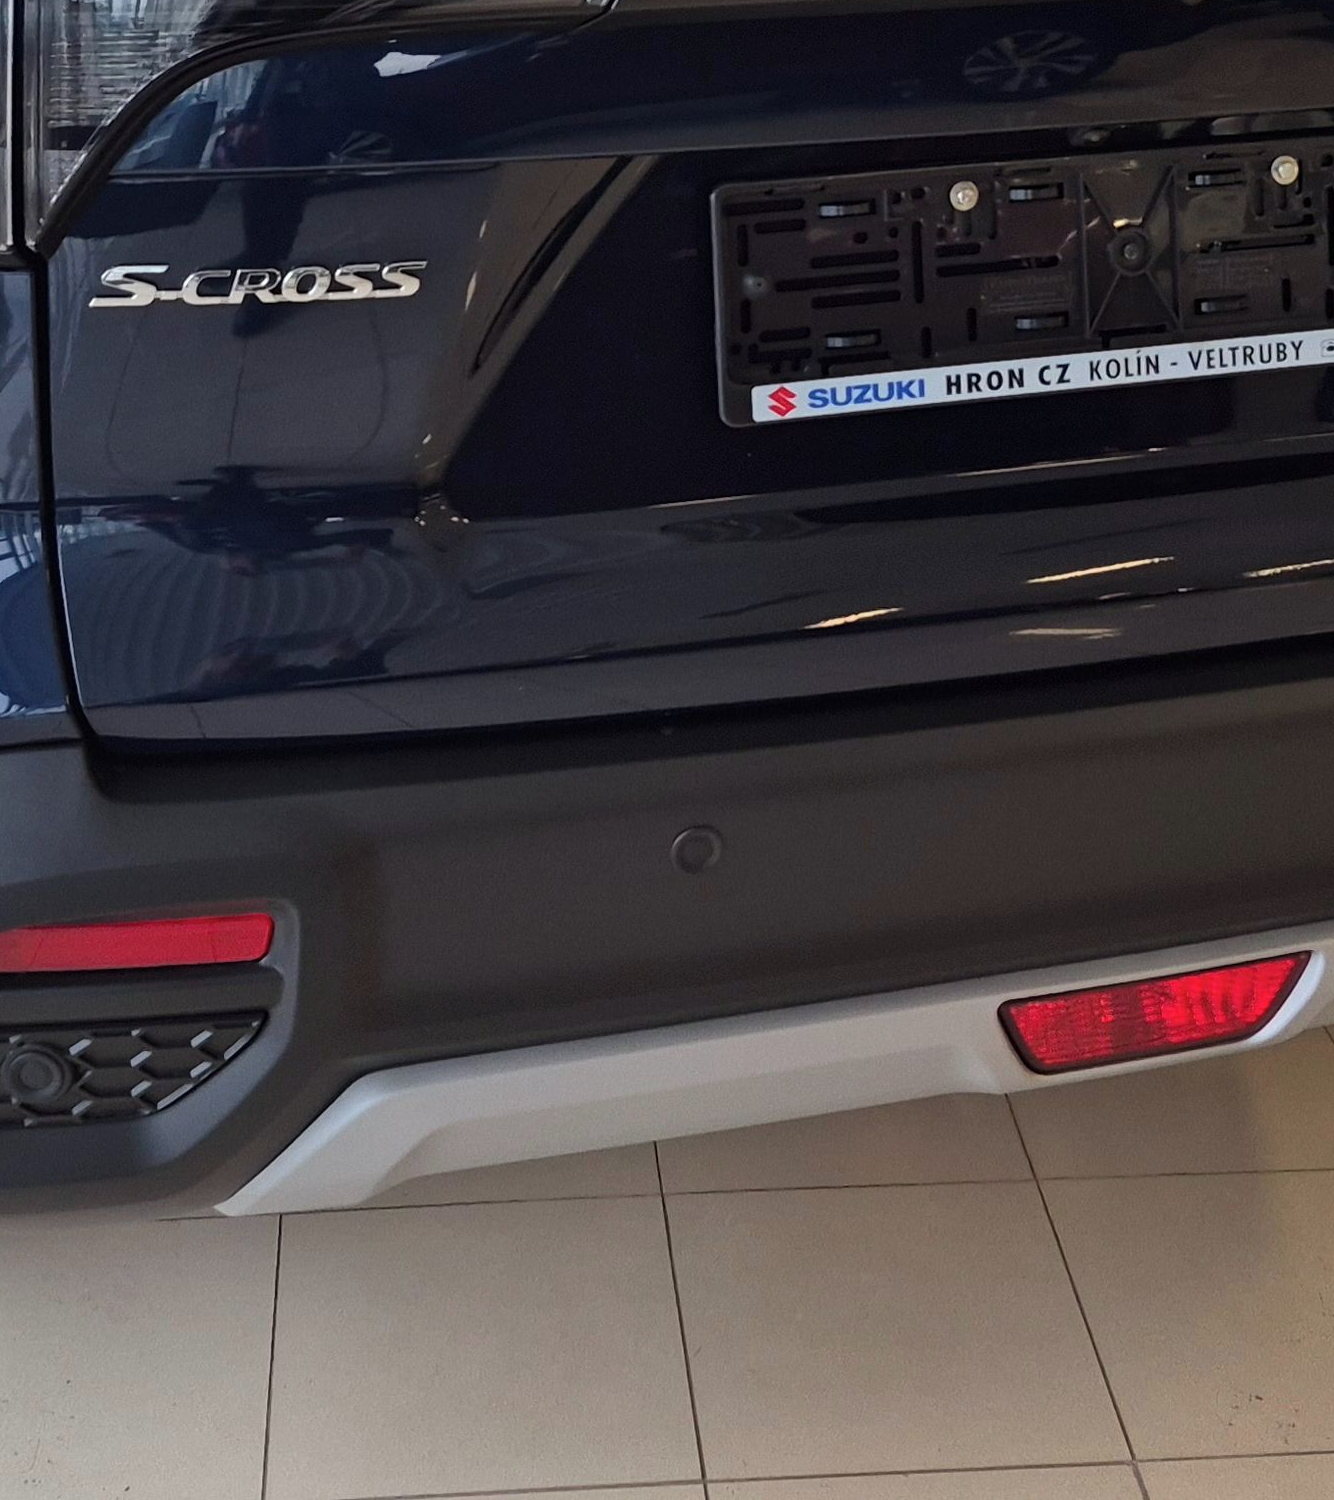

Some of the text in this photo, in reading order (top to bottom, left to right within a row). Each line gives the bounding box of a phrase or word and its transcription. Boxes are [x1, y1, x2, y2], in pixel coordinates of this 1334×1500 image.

[88, 260, 428, 309] S-CROSS
[807, 378, 926, 409] SUZUKI
[945, 367, 1025, 396] HRON
[1038, 363, 1072, 386] CZ
[1088, 349, 1160, 381] KOLÍN
[1188, 339, 1305, 371] VELTRUBY
